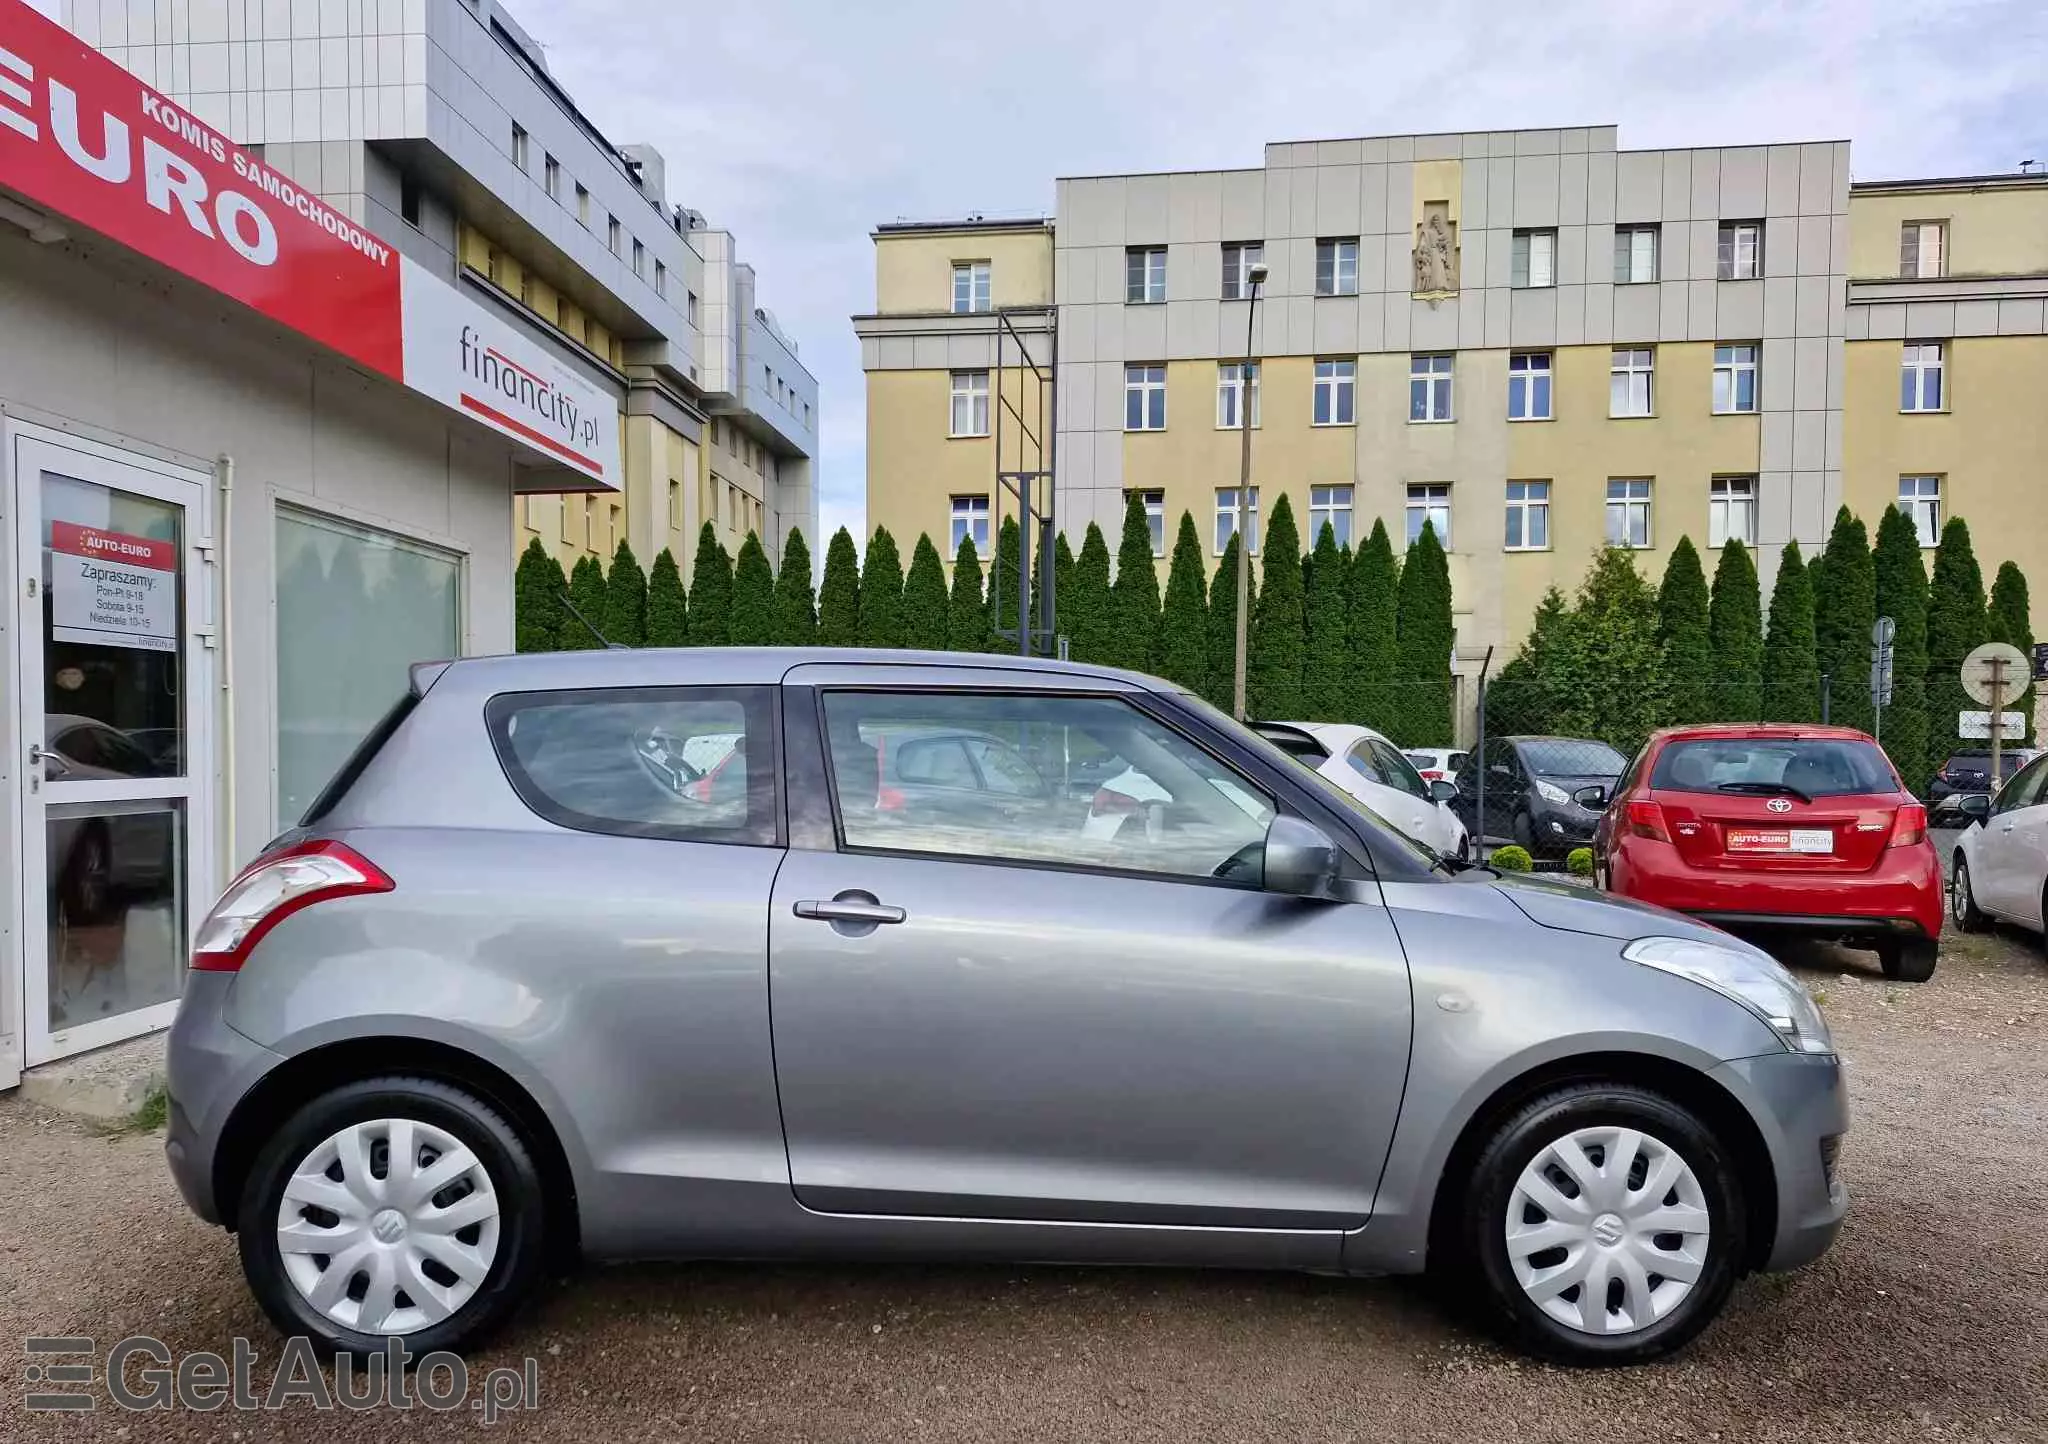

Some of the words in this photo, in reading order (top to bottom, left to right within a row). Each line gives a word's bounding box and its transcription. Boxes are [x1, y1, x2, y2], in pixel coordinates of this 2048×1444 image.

[0, 47, 279, 266] EURO
[141, 90, 226, 163] KOMIS
[233, 152, 389, 267] SAMOCHODOWY
[460, 325, 599, 448] financity.pl
[87, 536, 151, 557] AUTO-EURO
[96, 598, 125, 612] Sobota
[127, 602, 144, 614] 9-15
[1732, 835, 1789, 844] AUTO-EURO
